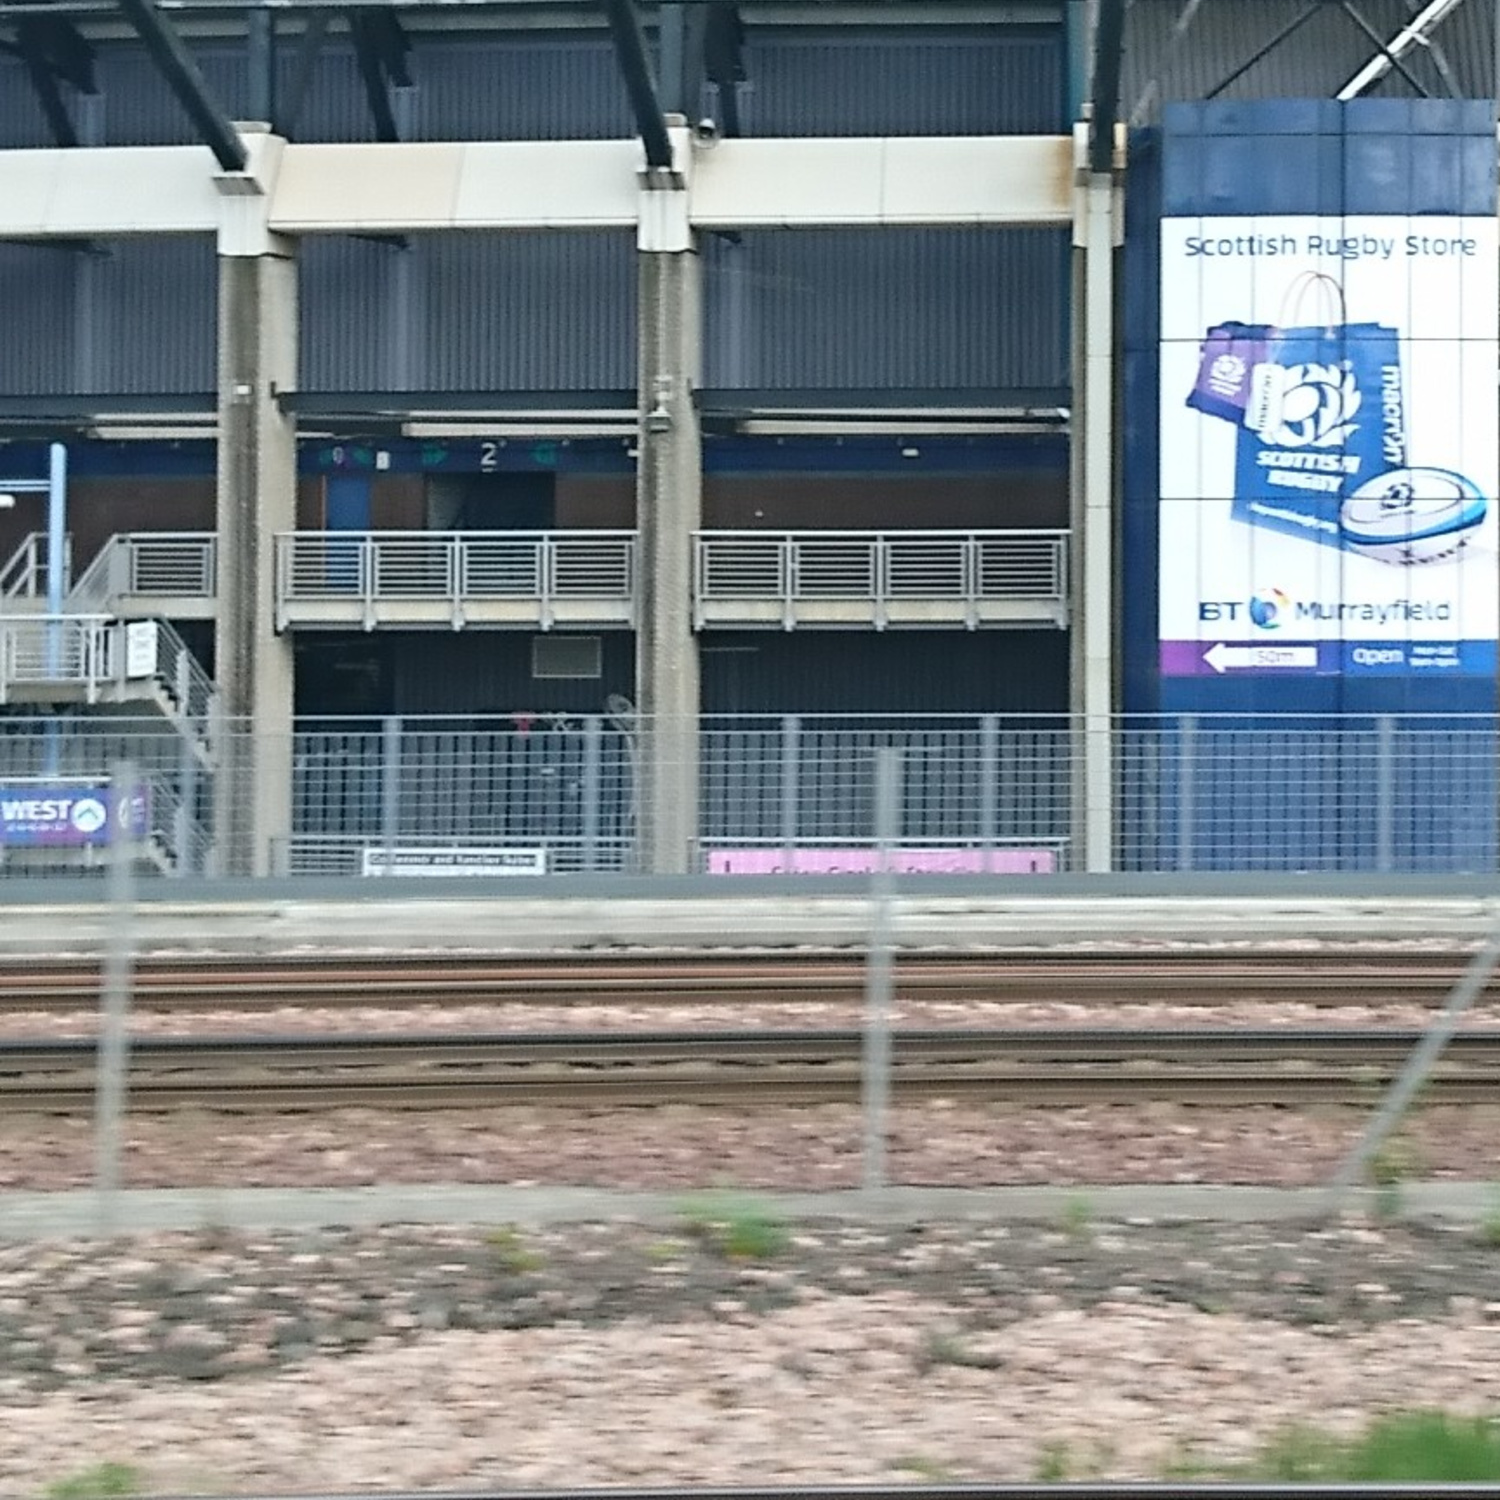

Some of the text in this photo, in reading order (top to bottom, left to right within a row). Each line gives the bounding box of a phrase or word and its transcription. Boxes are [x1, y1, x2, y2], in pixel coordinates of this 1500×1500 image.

[1184, 235, 1478, 260] Scottish Rugby Store
[480, 442, 498, 466] 2
[1199, 599, 1452, 625] BT Murrayfield
[1353, 647, 1404, 666] Open
[1, 799, 73, 821] WEST
